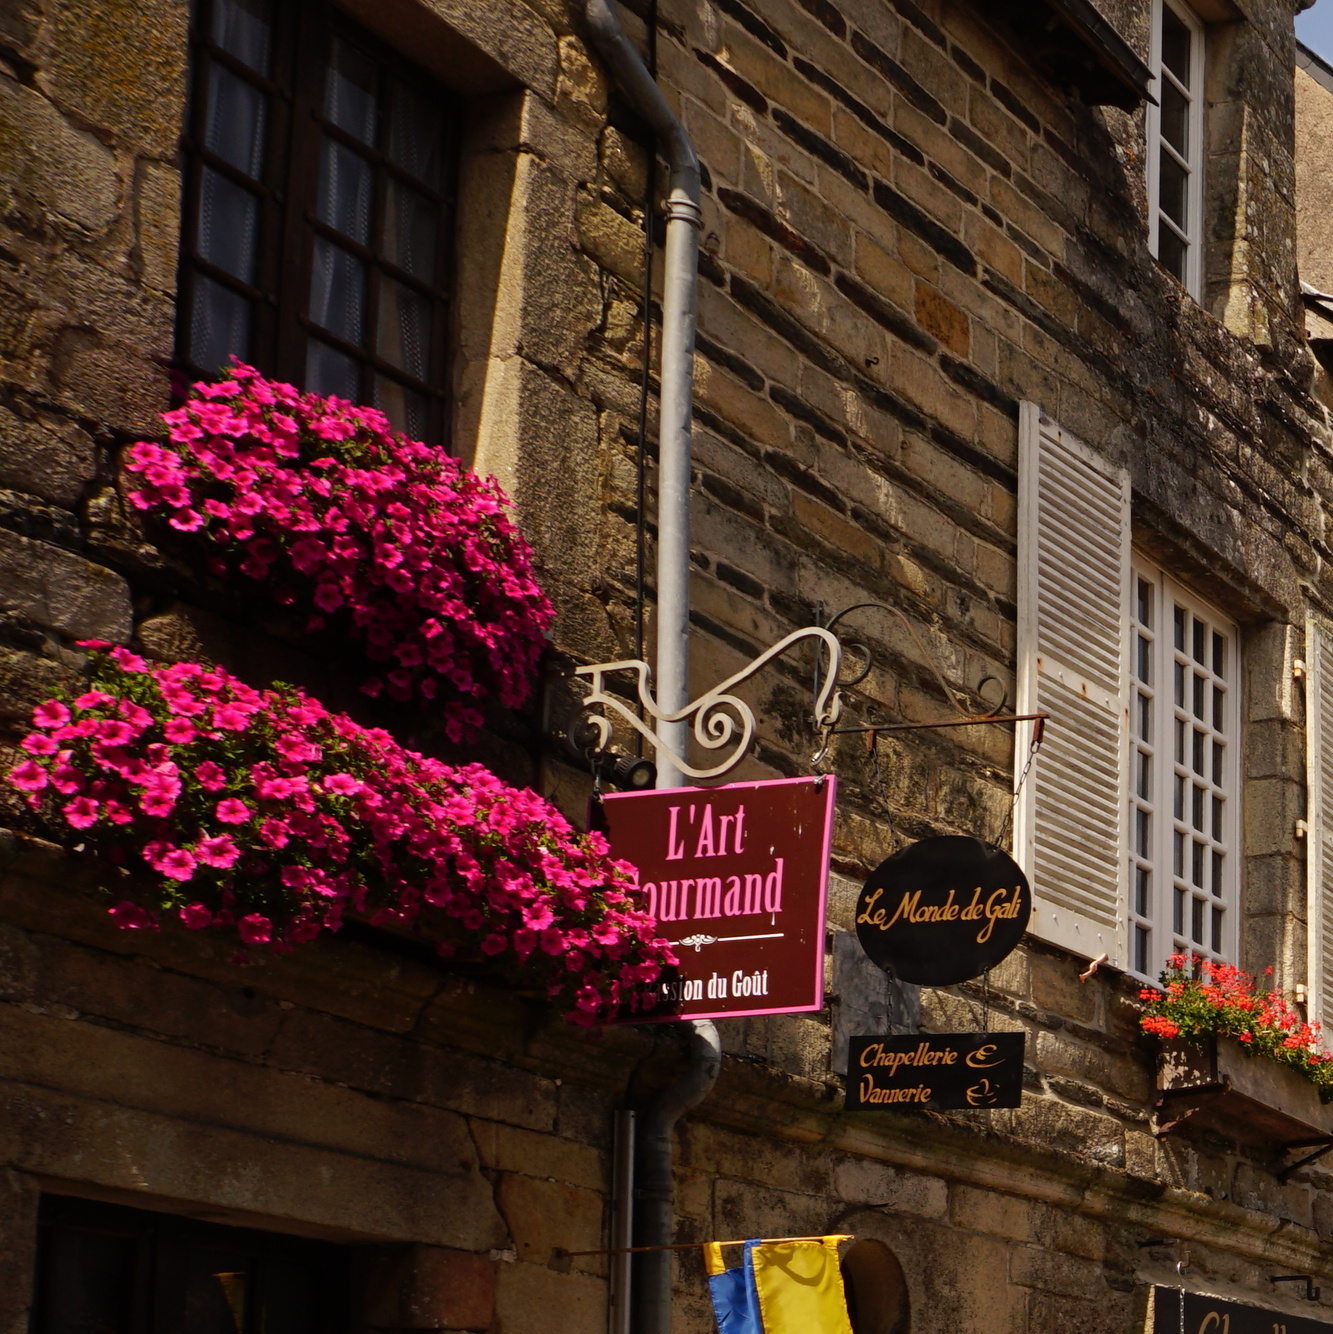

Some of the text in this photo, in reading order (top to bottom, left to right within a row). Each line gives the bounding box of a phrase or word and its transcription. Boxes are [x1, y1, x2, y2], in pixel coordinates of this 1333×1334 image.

[665, 803, 745, 861] L'Art
[630, 857, 784, 922] ourmand
[857, 885, 1021, 943] Le Monde de Gali
[707, 972, 728, 999] du
[731, 969, 769, 998] Goût
[859, 1042, 958, 1077] Chapellerie
[859, 1073, 932, 1104] Vannerie
